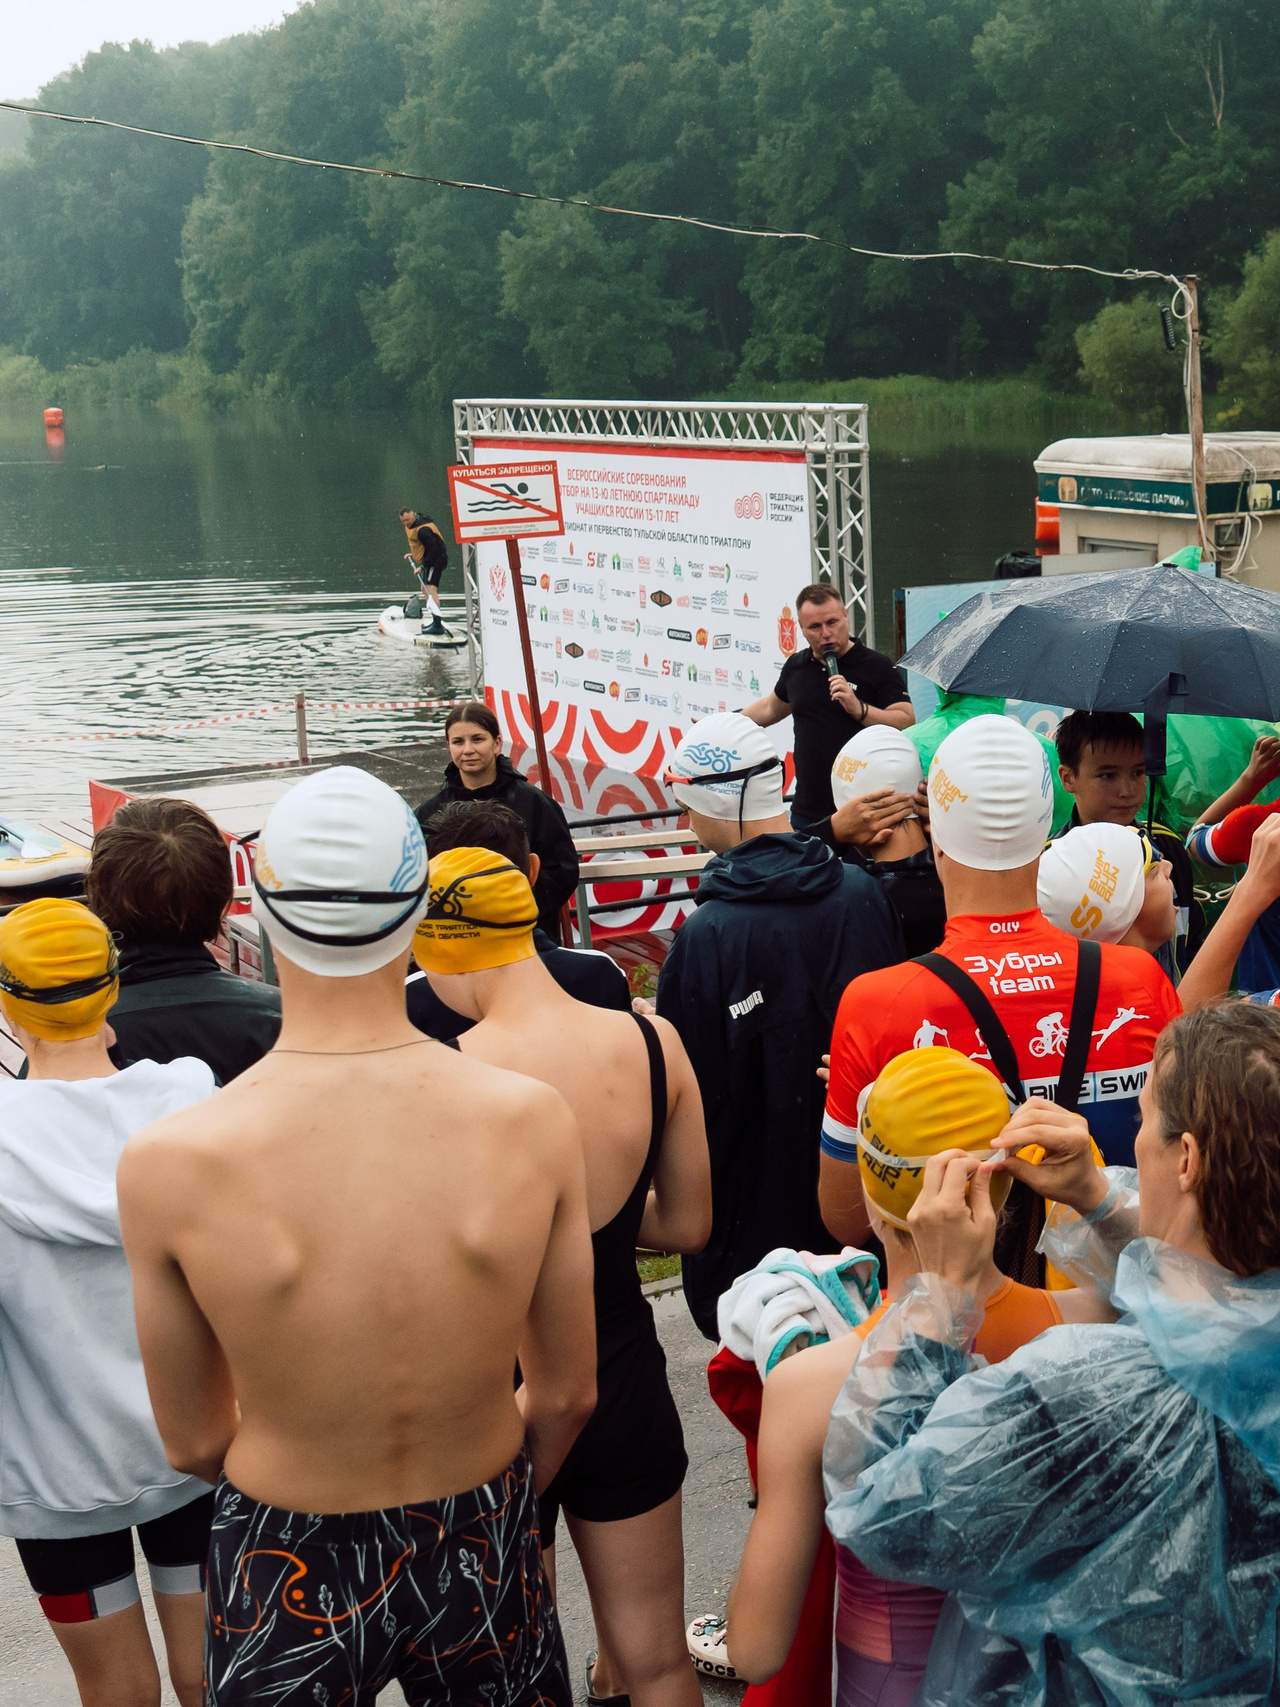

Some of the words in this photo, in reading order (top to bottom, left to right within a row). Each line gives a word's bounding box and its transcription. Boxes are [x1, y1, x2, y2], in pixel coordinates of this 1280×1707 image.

[453, 467, 496, 478] КУПАТЬСЯ
[498, 464, 553, 475] ЗАПРЕЩЕНО!
[567, 468, 625, 484] ВСЕРОССИЙСКИЕ
[626, 472, 687, 488] СОРЕВНОВАНИЯ
[580, 486, 590, 497] НА
[591, 487, 608, 499] 13-Ю
[610, 488, 643, 502] ЛЕТНЮЮ
[644, 491, 700, 508] СПАРТАКИАДУ
[769, 492, 804, 503] ФЕДЕРАЦИЯ
[576, 503, 615, 518] УЧАЩИХСЯ
[616, 505, 644, 520] РОССИИ
[645, 508, 664, 522] 15-17
[665, 510, 680, 523] ЛЕТ
[769, 503, 804, 513] ТРИАТЛОНА
[770, 513, 793, 522] РОССИИ
[565, 521, 588, 532] ПИОНАТ
[588, 523, 593, 532] И
[593, 524, 632, 537] ПЕРВЕНСТВО
[633, 528, 666, 541] ТУЛЬСКОЙ
[667, 532, 698, 544] ОБЛАСТИ
[699, 535, 709, 545] ПО
[710, 536, 752, 549] ТРИАТЛОНУ
[842, 756, 868, 769] SWIM
[938, 768, 968, 803] SWIM
[1088, 849, 1106, 892] SWIM
[1096, 862, 1110, 898] SUP
[1104, 866, 1120, 904] RUN
[989, 921, 1020, 934] OLLY
[963, 951, 1063, 977] Зубры
[989, 975, 1055, 995] team
[729, 990, 764, 1020] PUMA
[1029, 1078, 1090, 1101] BIE
